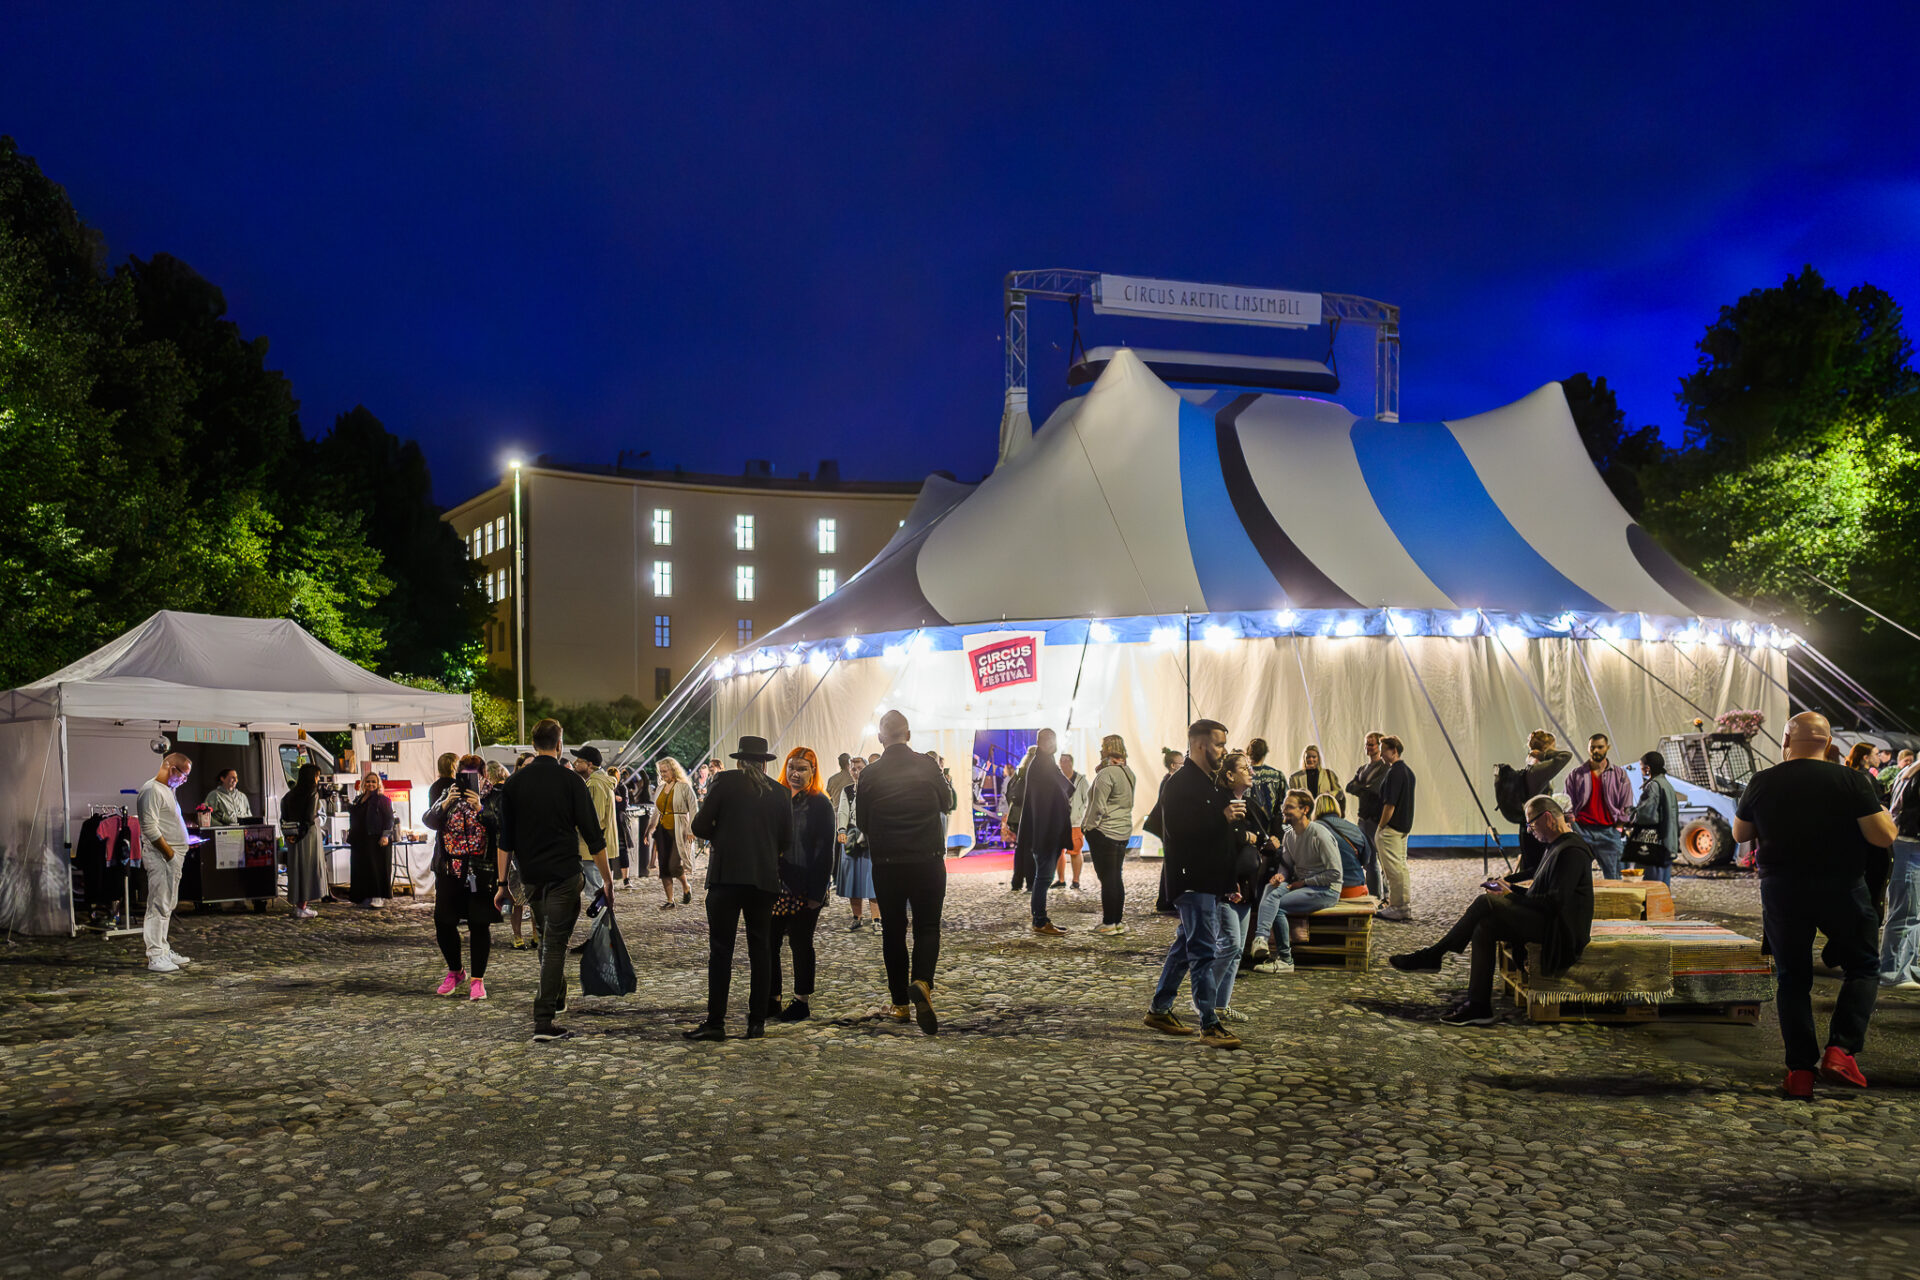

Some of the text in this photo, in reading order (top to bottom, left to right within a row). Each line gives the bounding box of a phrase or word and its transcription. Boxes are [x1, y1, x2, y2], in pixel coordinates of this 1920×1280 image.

[1124, 284, 1301, 316] CIRCUS ARCTIC ENSEMBLE
[978, 645, 1031, 667] CIRCUS
[978, 657, 1027, 678] RUSKA
[982, 667, 1031, 687] FESTIVAL
[1737, 1008, 1755, 1017] FIN
